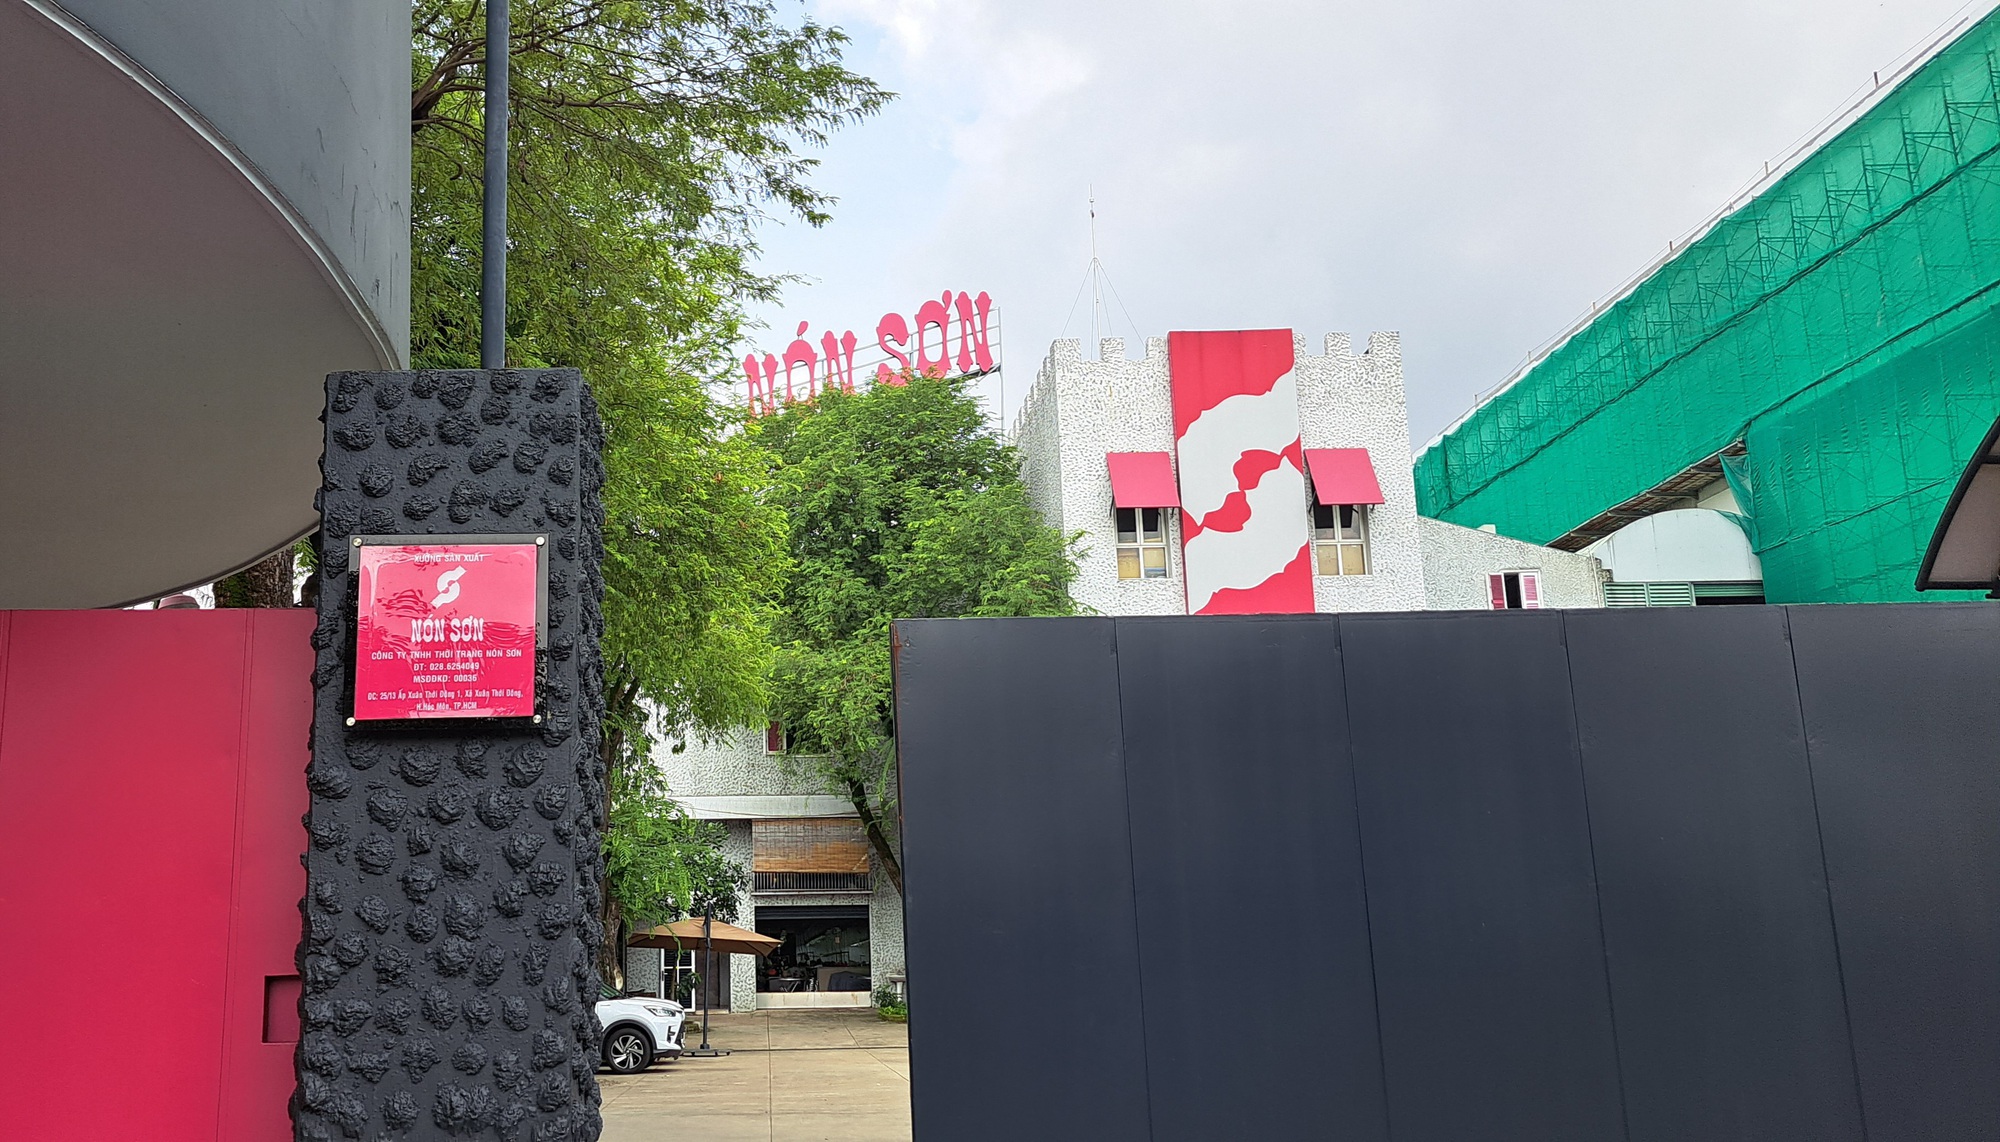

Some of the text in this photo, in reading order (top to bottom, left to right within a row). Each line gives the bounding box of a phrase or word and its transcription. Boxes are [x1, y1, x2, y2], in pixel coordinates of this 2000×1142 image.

[742, 289, 993, 419] NÓN SƠN
[411, 614, 484, 643] NÓN SƠN
[371, 650, 394, 660] CÔNG
[397, 651, 407, 659] TY
[410, 651, 432, 659] TNHH
[456, 649, 483, 658] TRANG
[486, 647, 503, 657] NÓN
[506, 647, 522, 657] SƠN
